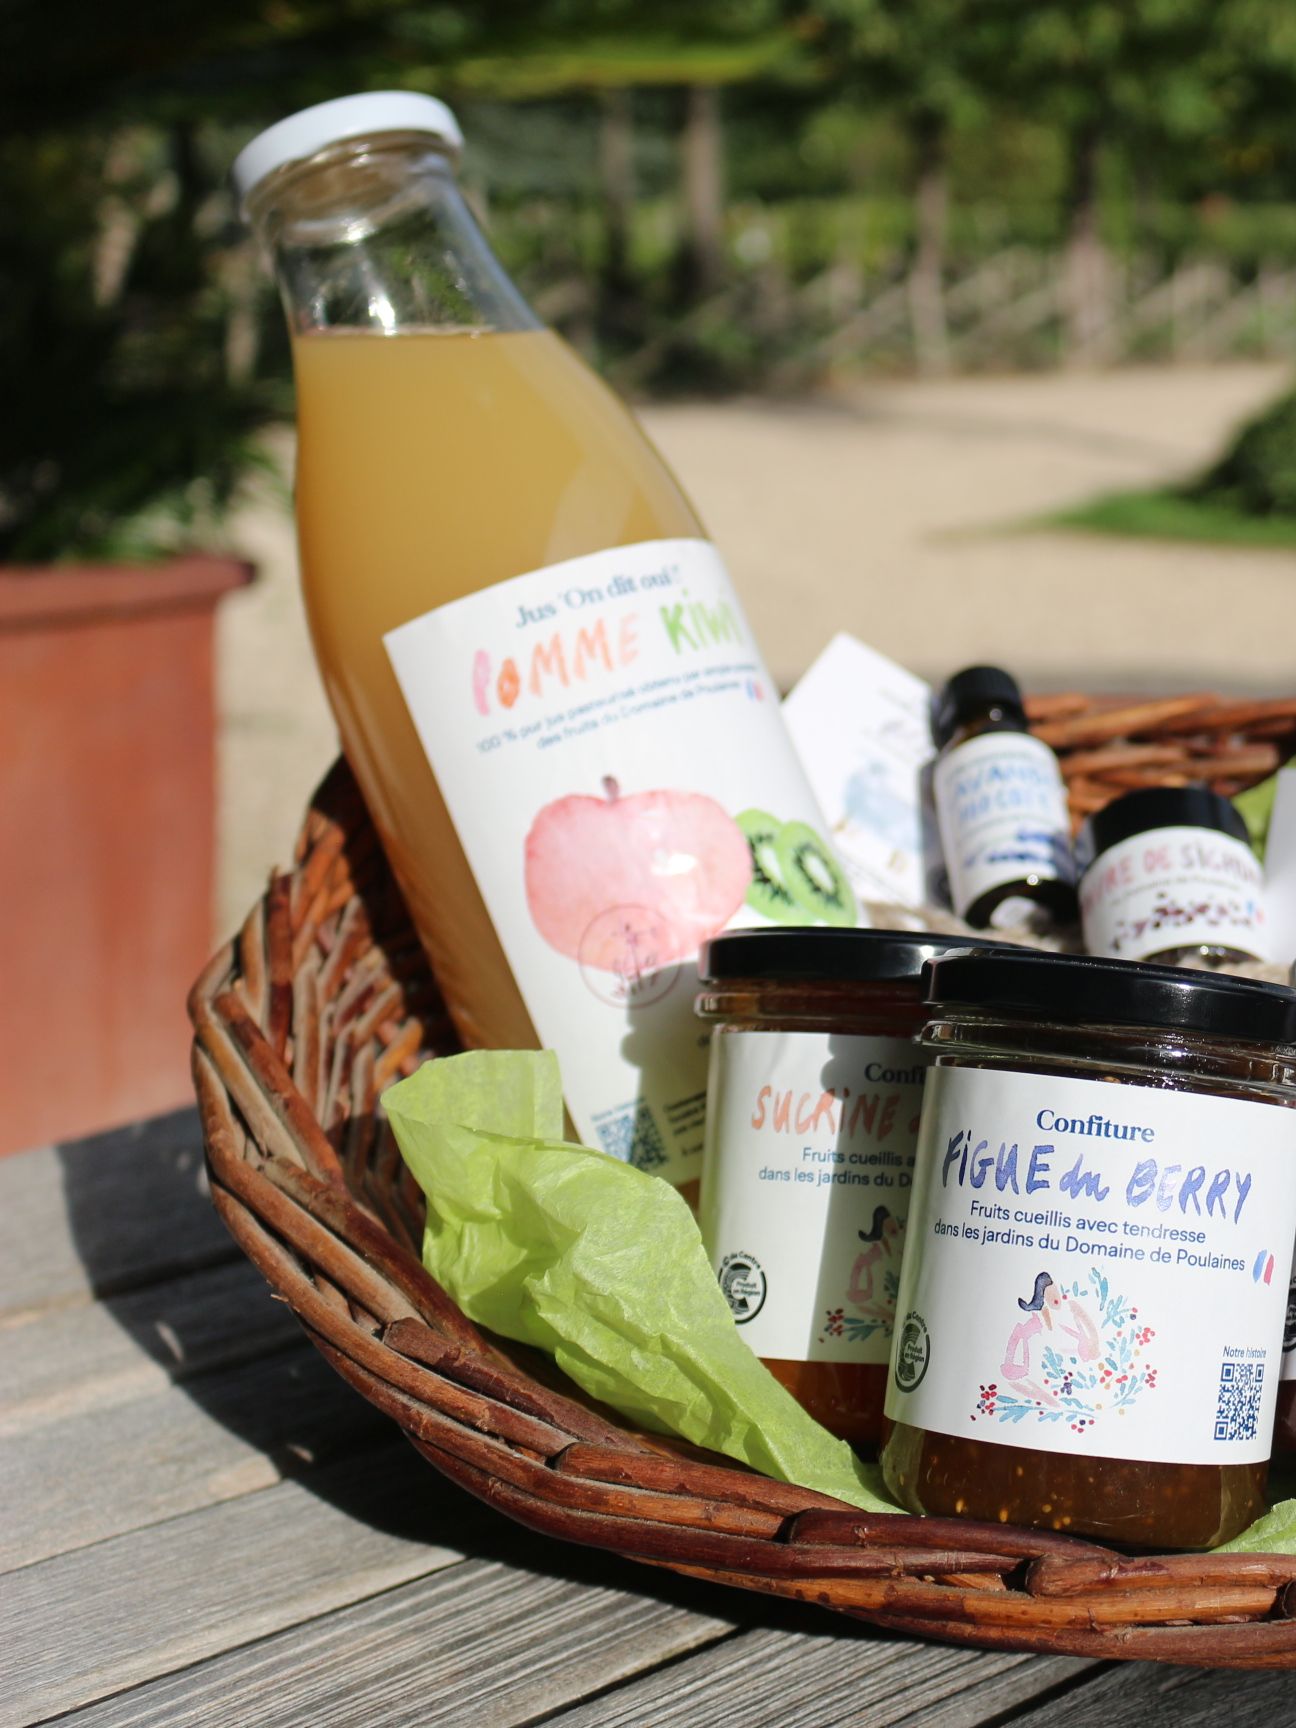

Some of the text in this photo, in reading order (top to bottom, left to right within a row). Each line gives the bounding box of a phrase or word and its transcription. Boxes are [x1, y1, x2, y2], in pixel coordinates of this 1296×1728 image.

[515, 604, 557, 629] Jus
[607, 573, 638, 601] dit
[1036, 1109, 1155, 1143] Confiture
[802, 1147, 845, 1165] Fruits
[848, 1150, 903, 1167] cueillis
[758, 1166, 791, 1182] dans
[794, 1167, 814, 1182] les
[817, 1168, 870, 1187] jardins
[874, 1172, 894, 1187] du
[1126, 1158, 1252, 1225] BERRY
[970, 1200, 1207, 1243] Fruits cueillis avec tendresse
[934, 1218, 1246, 1271] dans les jardins du Domaine de Poulaines
[1222, 1345, 1245, 1358] Notre
